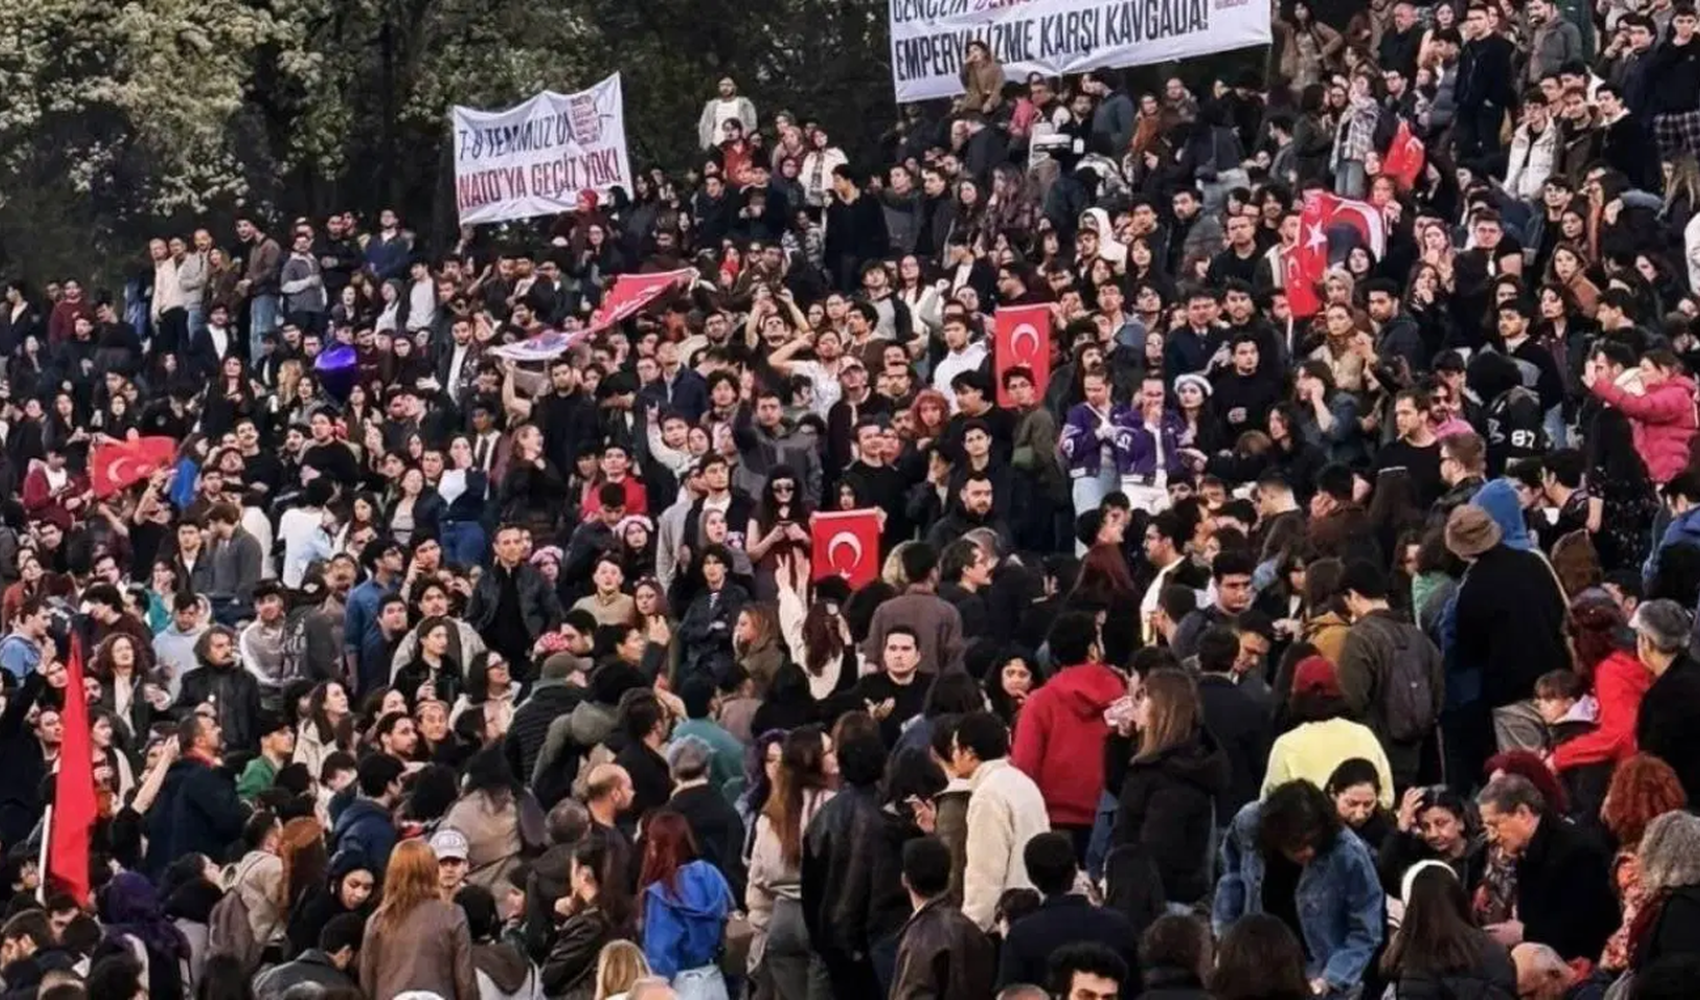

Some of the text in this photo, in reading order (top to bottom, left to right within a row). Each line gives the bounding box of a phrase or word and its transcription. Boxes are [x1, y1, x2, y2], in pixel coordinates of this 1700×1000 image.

[1040, 7, 1101, 57] KARŞI
[1105, 0, 1209, 45] KAVGADA!
[459, 147, 622, 210] NATO'YA GEÇİT YOK!
[1511, 429, 1535, 449] 87
